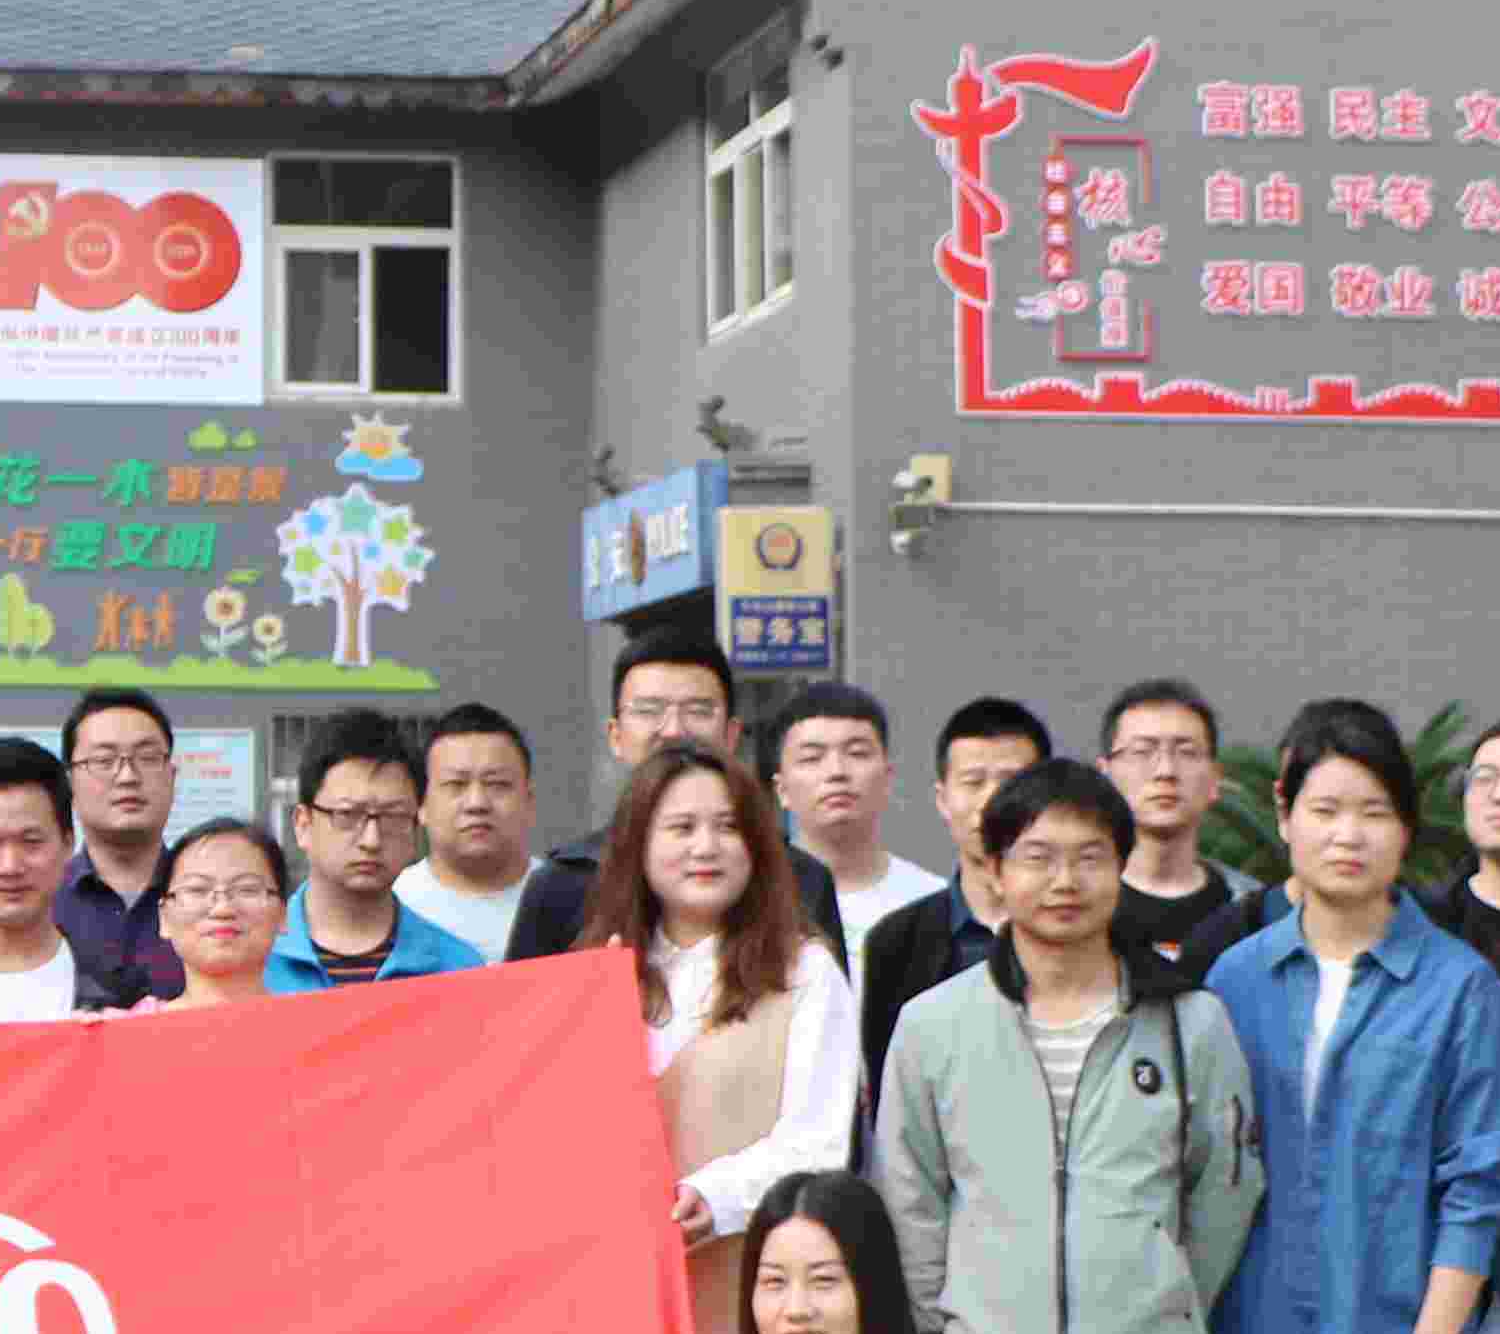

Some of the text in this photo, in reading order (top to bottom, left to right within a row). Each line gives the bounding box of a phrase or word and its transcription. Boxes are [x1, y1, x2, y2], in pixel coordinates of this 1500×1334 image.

[1197, 81, 1304, 140] 富强
[1328, 85, 1432, 142] 民主
[1204, 168, 1302, 225] 自由
[1327, 172, 1433, 233] 平等
[1201, 260, 1304, 316] 爱国
[1329, 263, 1437, 320] 敬业
